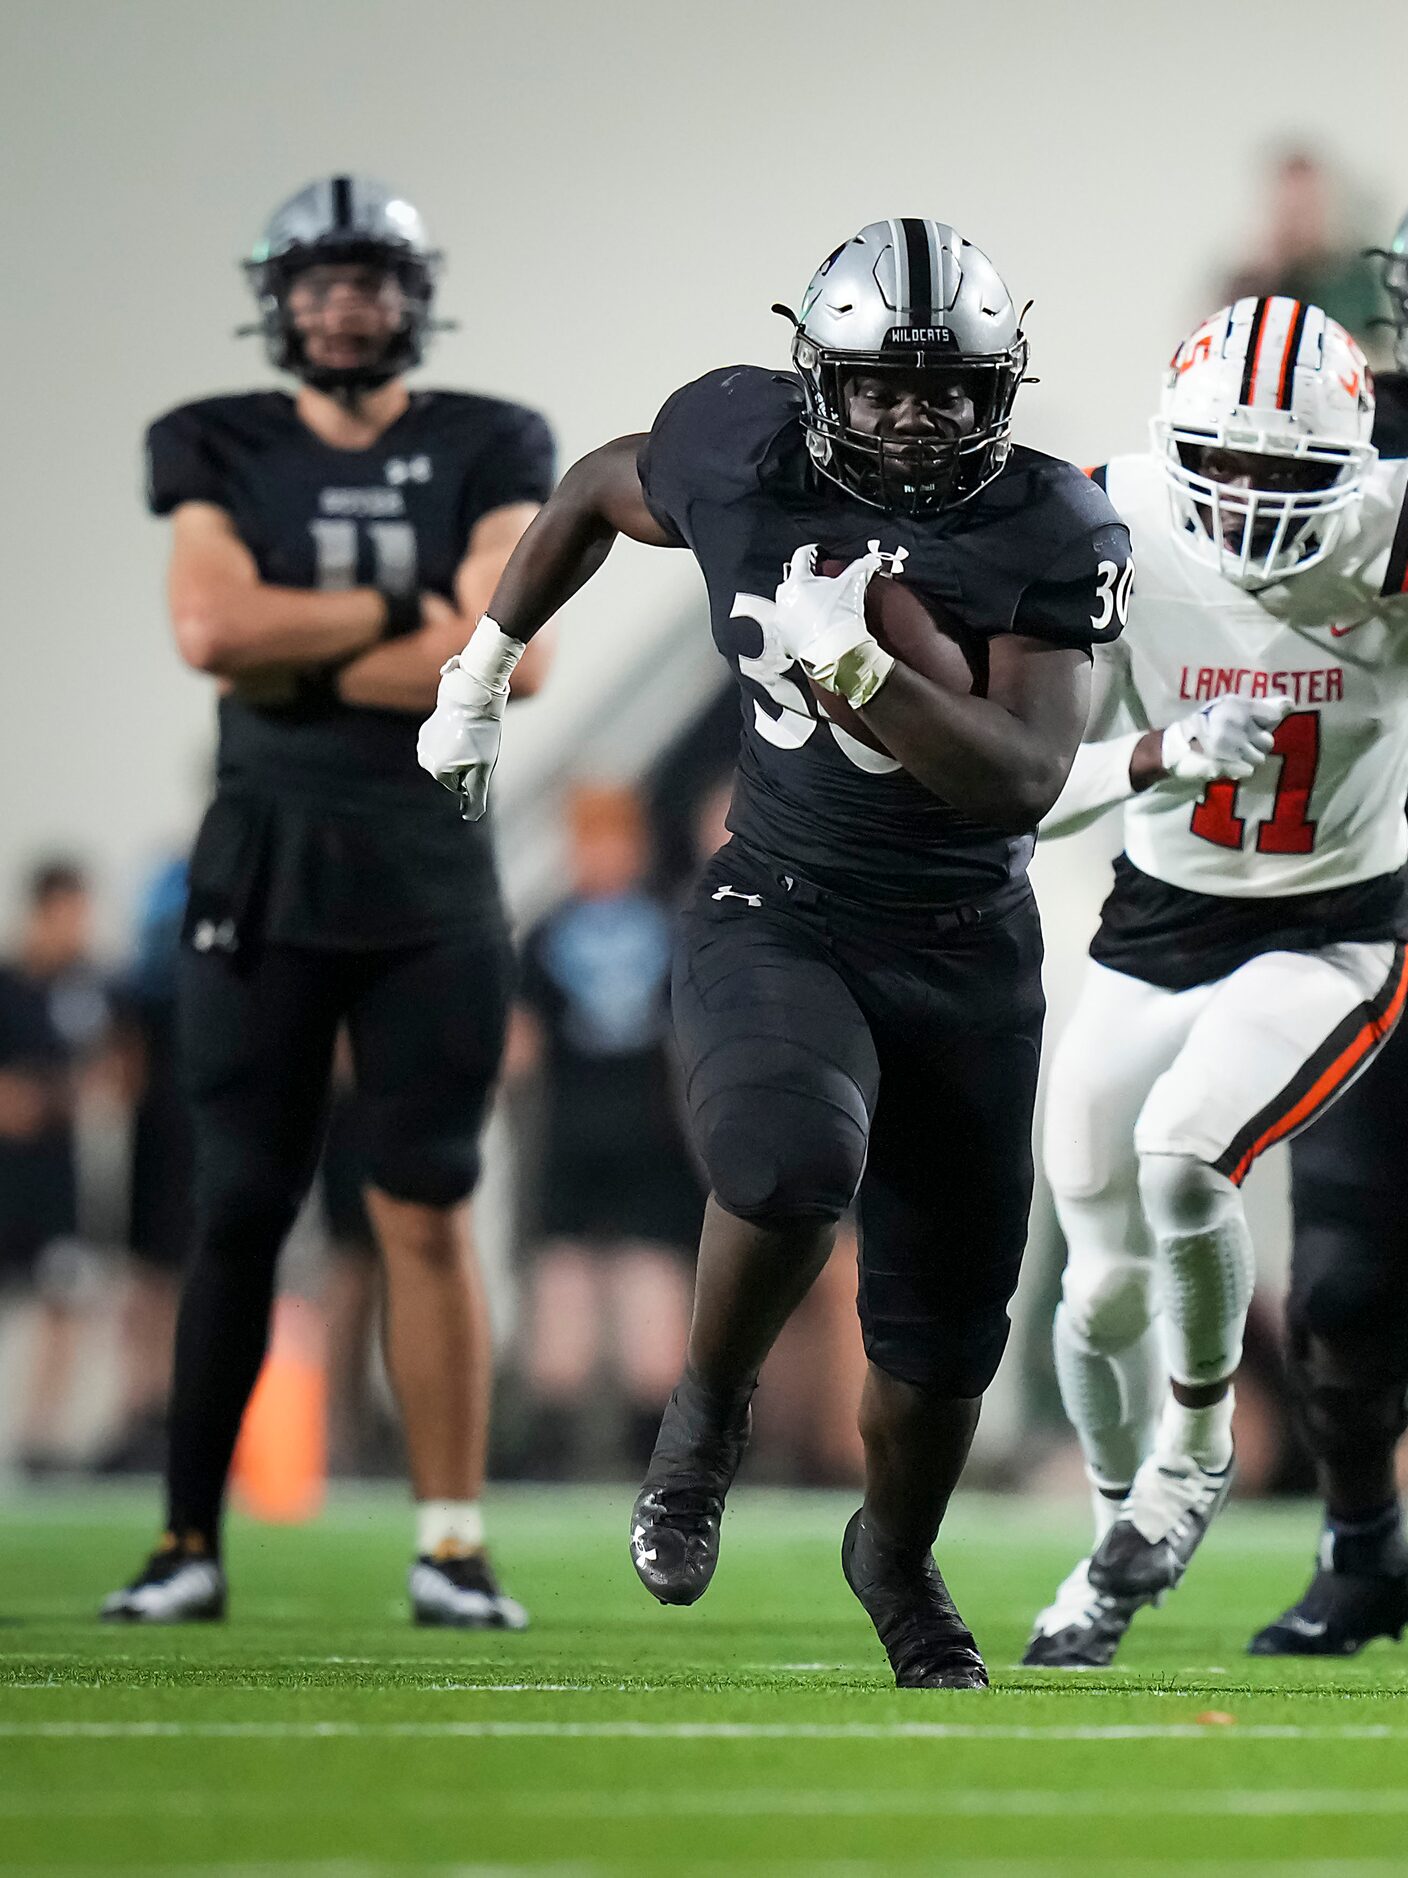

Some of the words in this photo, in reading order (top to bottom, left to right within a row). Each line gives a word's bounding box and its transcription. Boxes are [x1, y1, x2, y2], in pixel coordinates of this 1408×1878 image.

[892, 328, 949, 343] WILDCATS
[1089, 556, 1136, 630] 30
[729, 592, 903, 775] 3
[1179, 666, 1344, 705] LANCASTER
